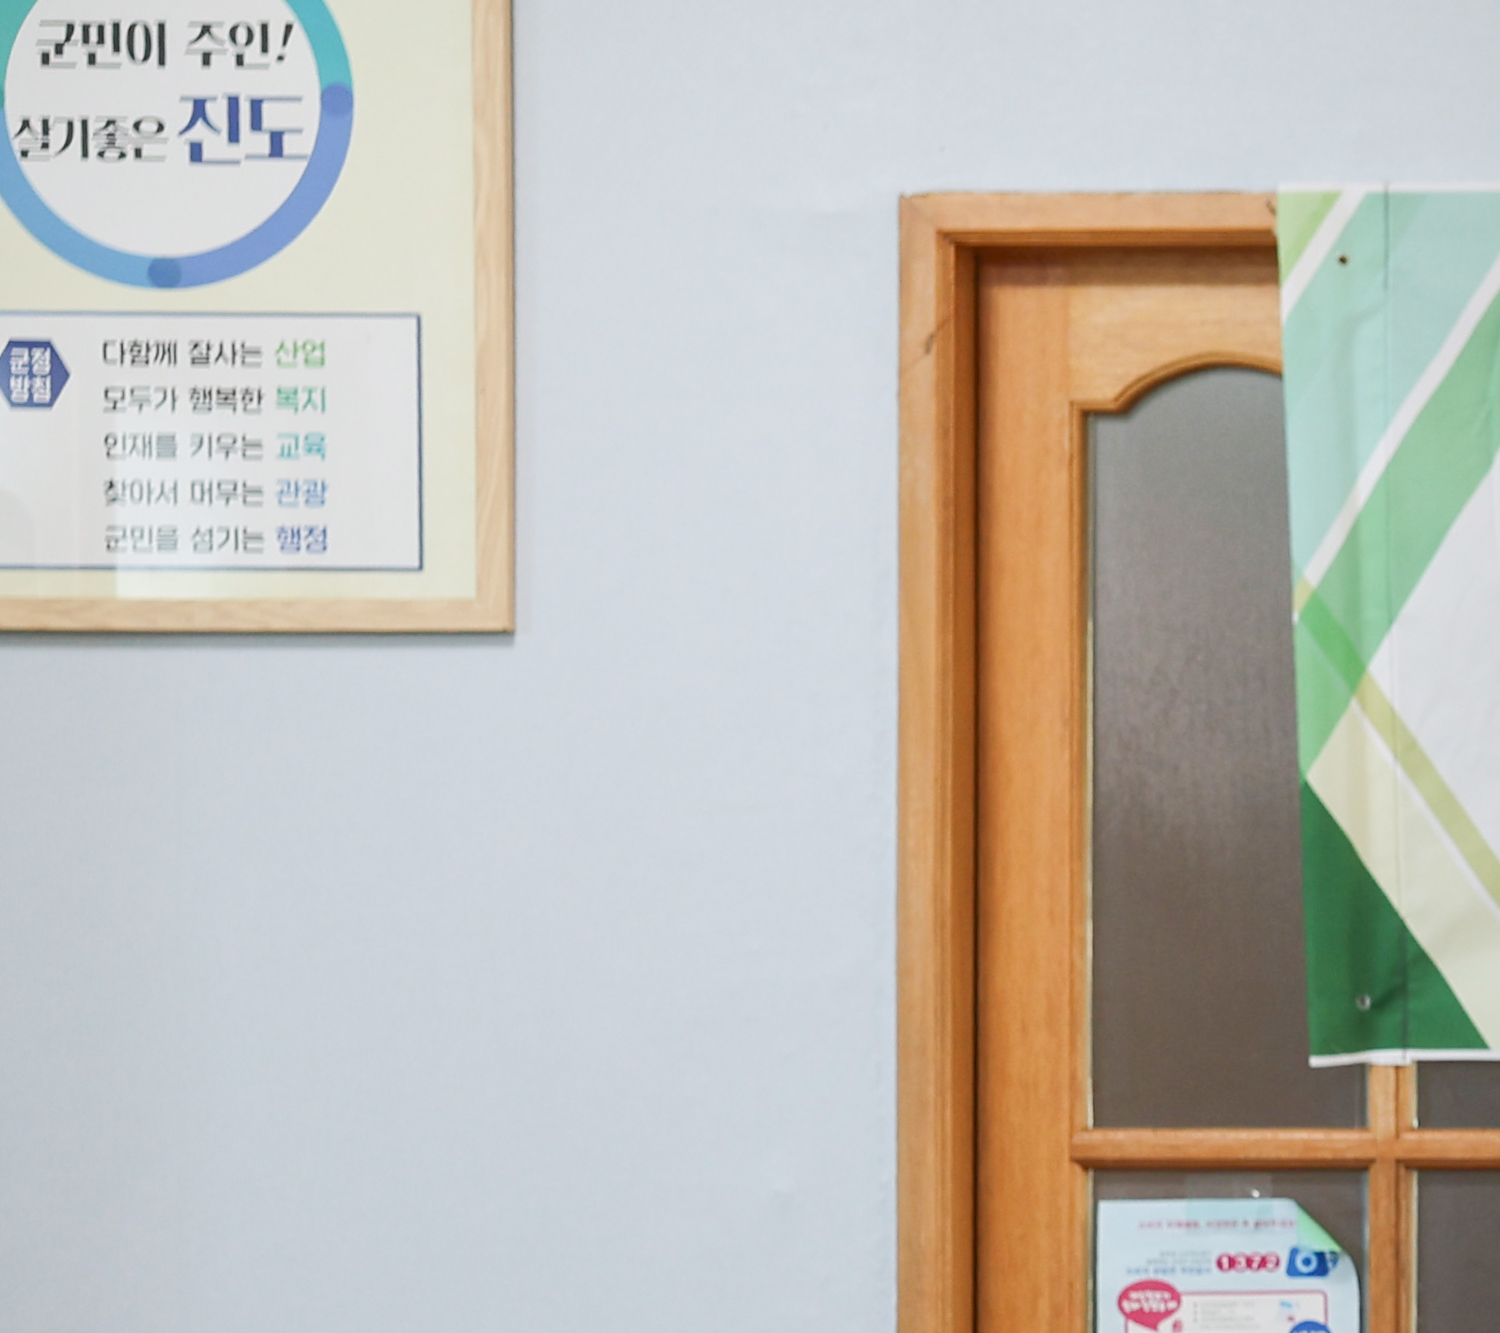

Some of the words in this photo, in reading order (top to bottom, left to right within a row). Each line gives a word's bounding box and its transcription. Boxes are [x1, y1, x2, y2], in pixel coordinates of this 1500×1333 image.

[35, 18, 166, 70] 군민이
[184, 19, 296, 70] 주인!
[13, 114, 169, 163] 살기좋은
[177, 91, 309, 166] 진도
[102, 339, 178, 368] 다함께
[188, 339, 263, 368] 잘사는
[275, 338, 326, 368] 산업
[102, 385, 178, 415] 모두가
[189, 385, 264, 415] 행복한
[275, 385, 327, 414] 복지
[103, 431, 178, 461] 인재를
[189, 432, 264, 461] 키우는
[275, 431, 327, 461] 교육
[103, 478, 179, 508] 찾아서
[190, 478, 265, 508] 머무는
[275, 478, 328, 508] 관광
[104, 524, 179, 555] 군민을
[190, 524, 265, 555] 섬기는
[276, 524, 329, 555] 행정
